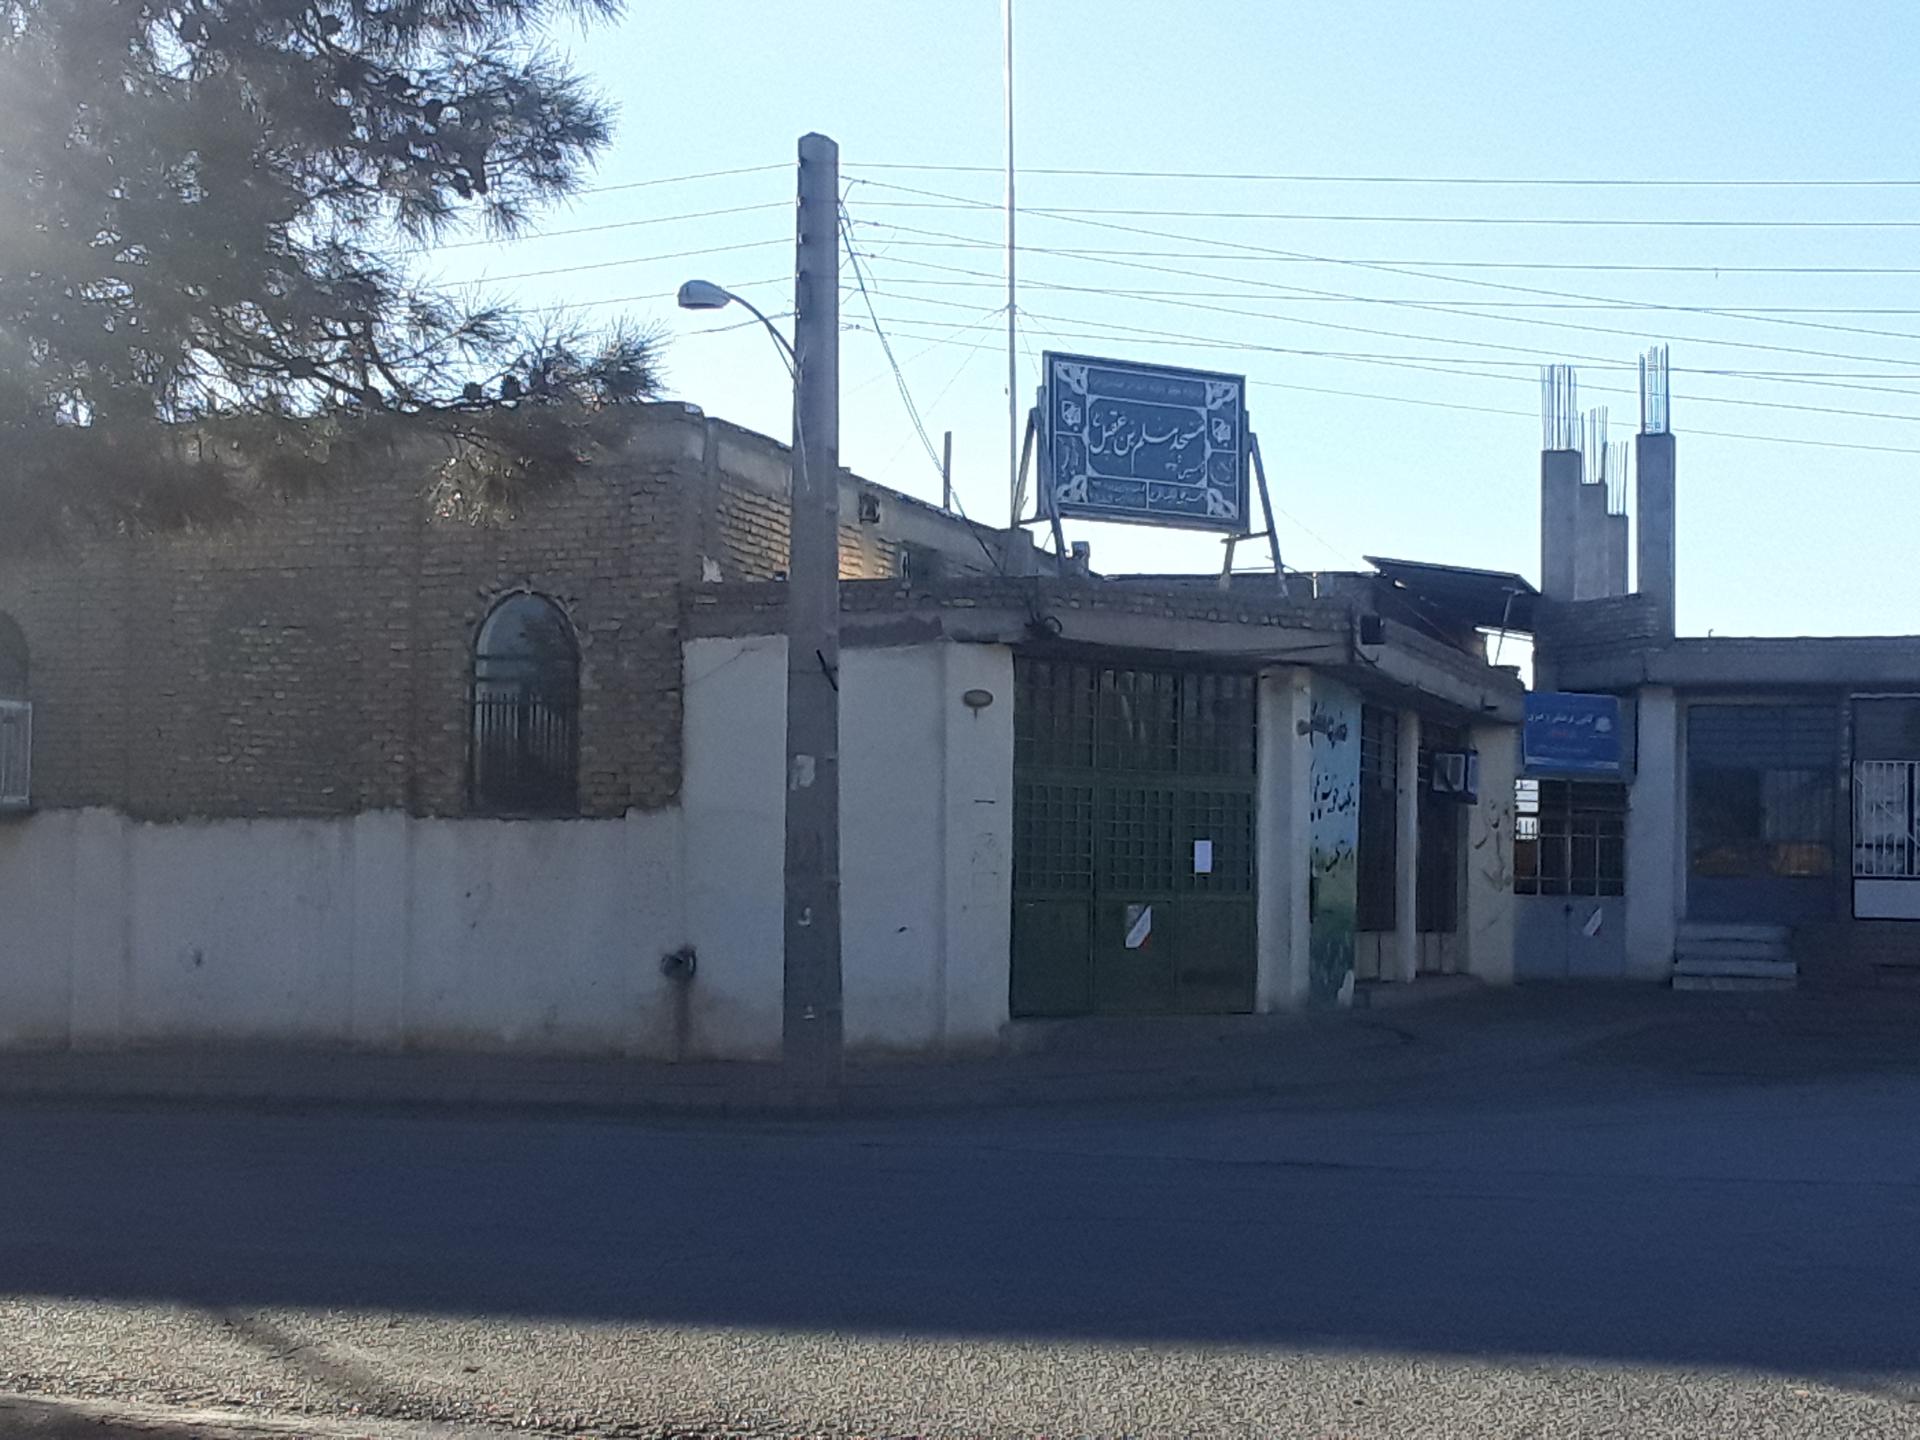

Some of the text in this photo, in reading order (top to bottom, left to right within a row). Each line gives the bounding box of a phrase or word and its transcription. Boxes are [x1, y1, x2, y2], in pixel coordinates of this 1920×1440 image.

[1113, 430, 1136, 456] بن
[1131, 423, 1179, 476] مسلم
[1169, 423, 1205, 451] مسجد
